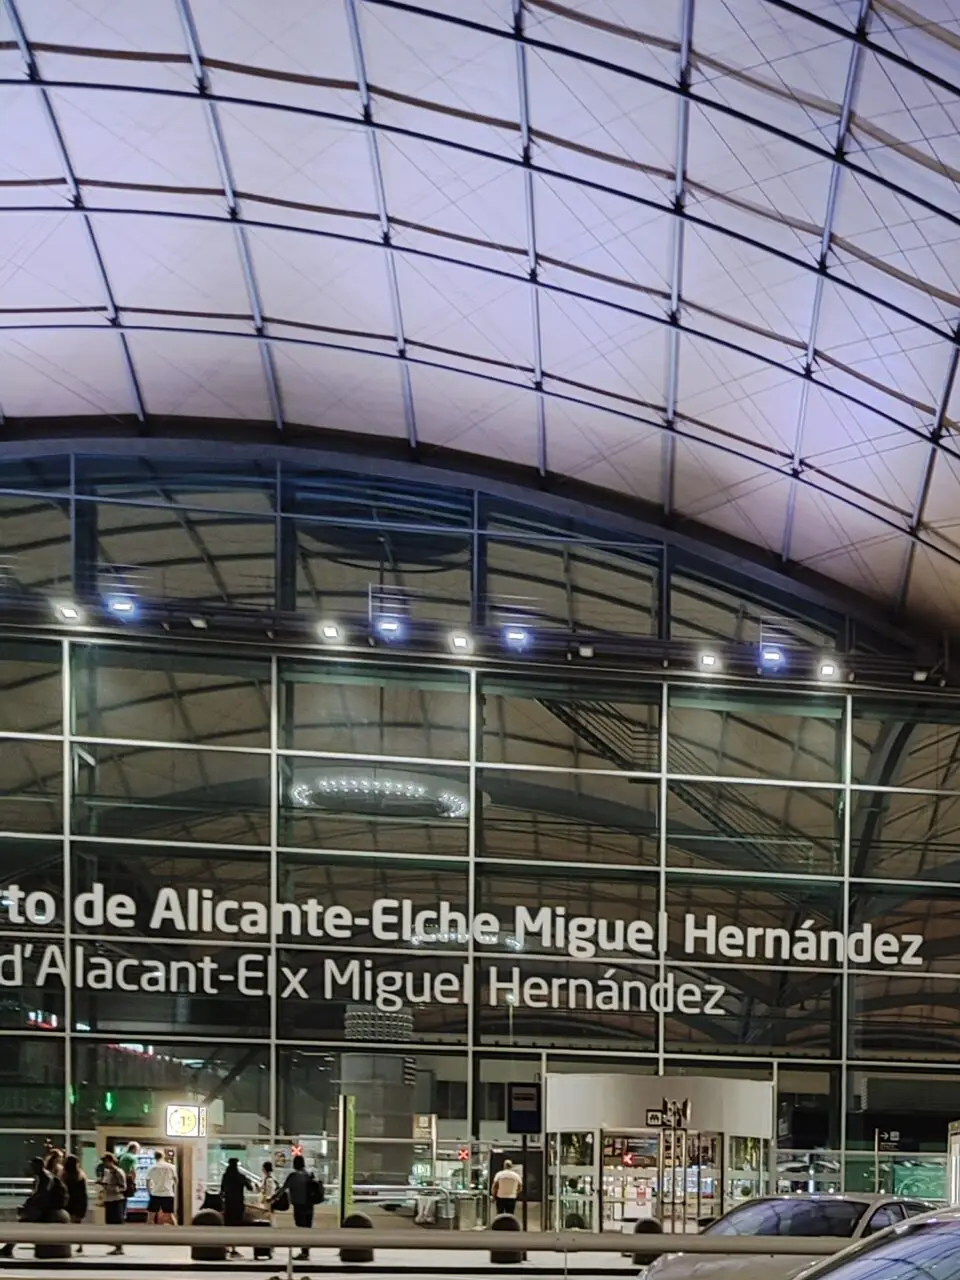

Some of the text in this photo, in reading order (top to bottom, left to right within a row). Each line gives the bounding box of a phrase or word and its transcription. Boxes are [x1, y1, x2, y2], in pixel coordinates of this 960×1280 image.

[74, 883, 137, 928] de
[149, 887, 500, 945] Alicante-Elche
[514, 905, 667, 958] Miguel
[684, 913, 924, 965] Hernández
[324, 958, 470, 1012] Miguel
[489, 966, 726, 1015] Hernández
